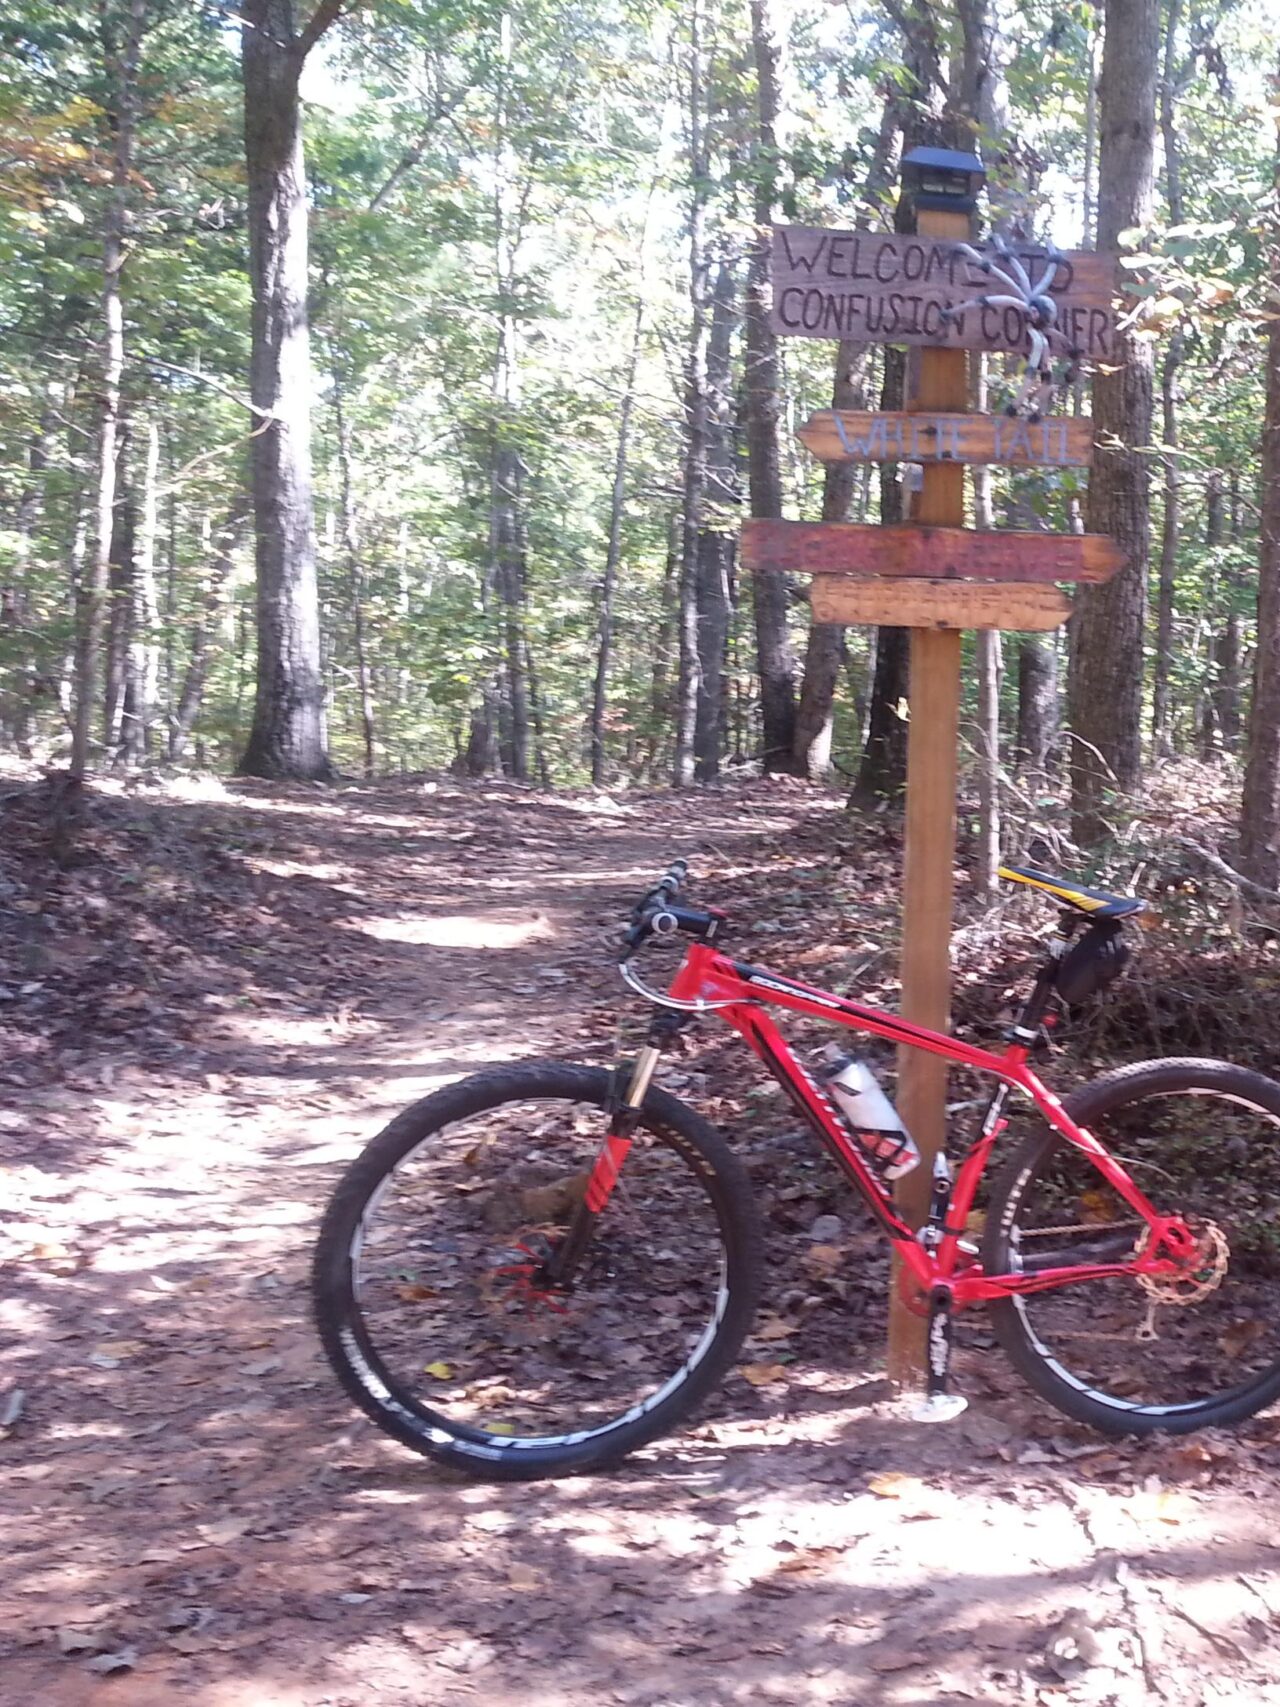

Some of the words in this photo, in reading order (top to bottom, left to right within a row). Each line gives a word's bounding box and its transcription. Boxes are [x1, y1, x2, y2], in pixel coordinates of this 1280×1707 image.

[782, 231, 987, 287] WELCOME
[1019, 252, 1074, 292] TO
[779, 287, 965, 339] CONFUSION
[833, 411, 975, 461] WHITE
[987, 415, 1083, 465] TAIL
